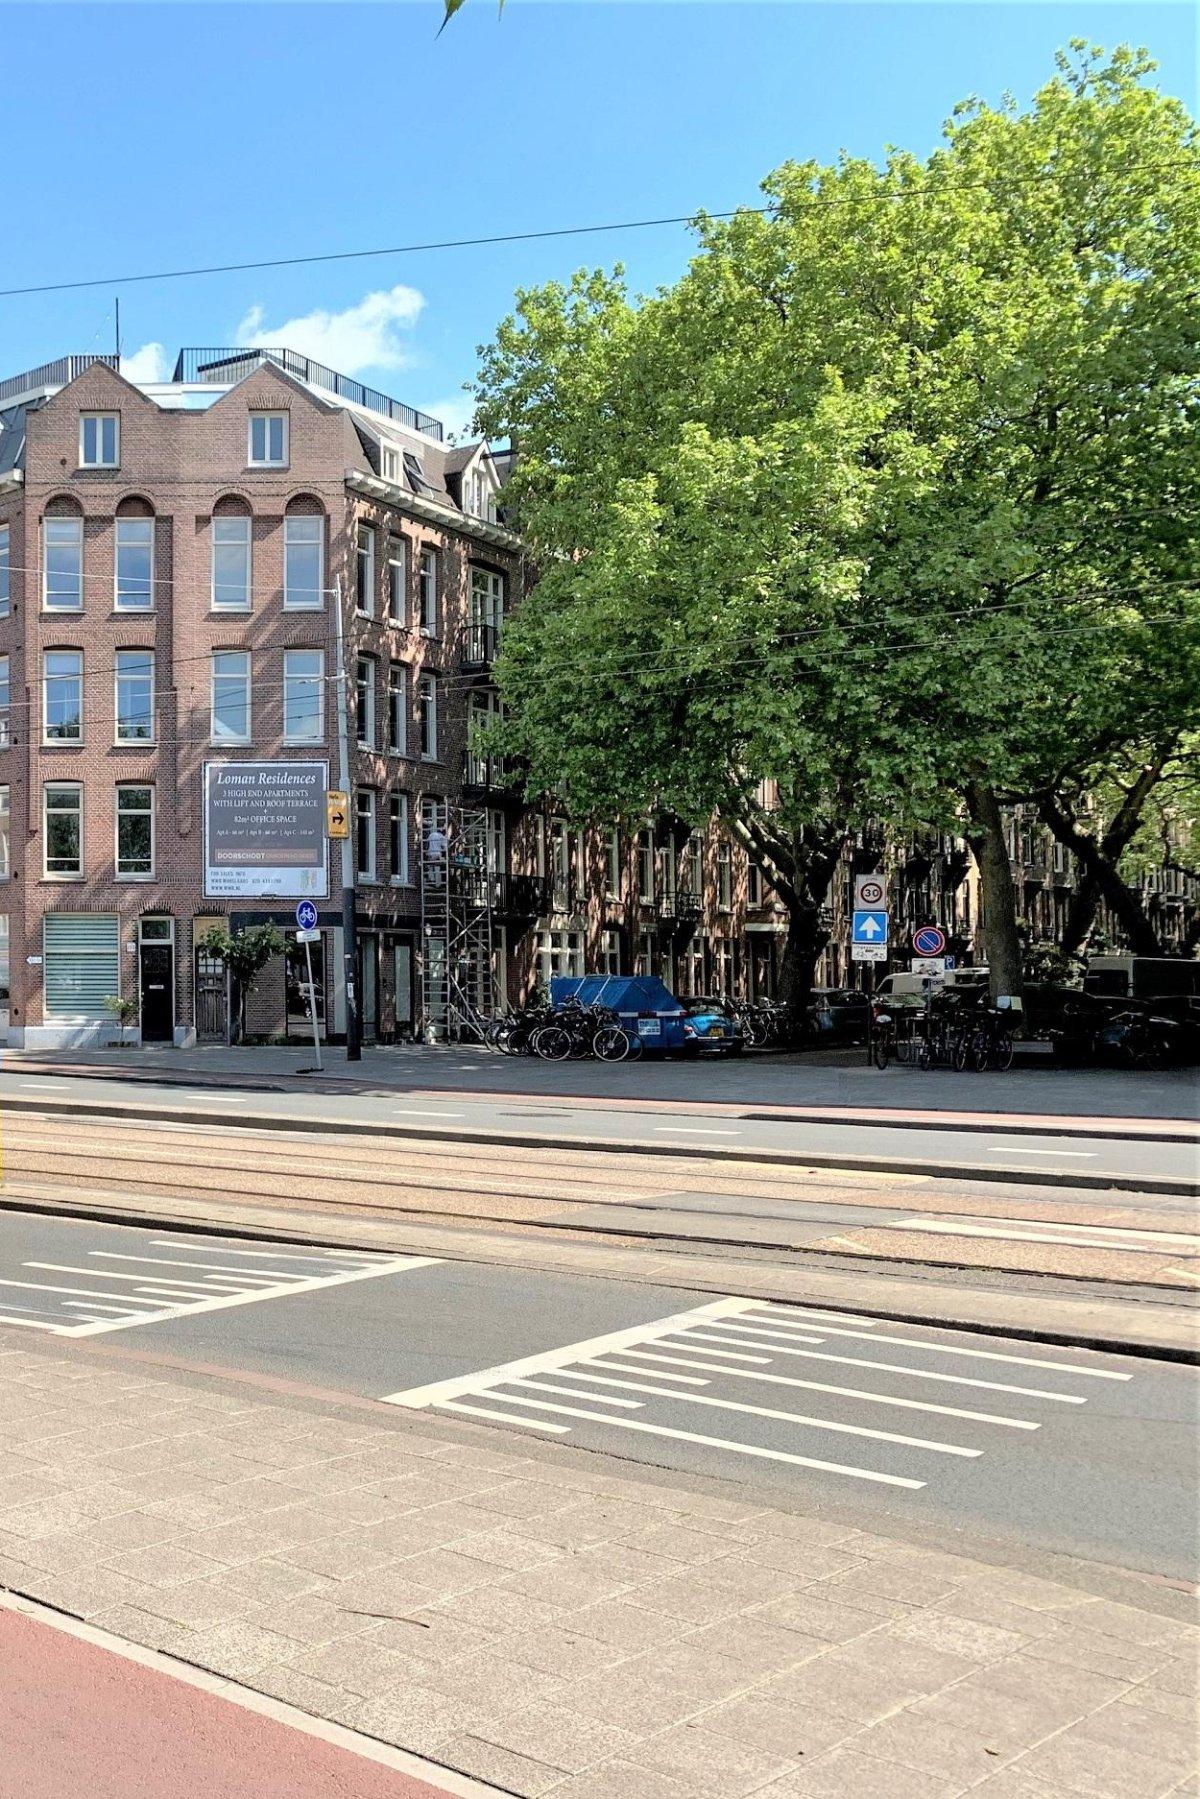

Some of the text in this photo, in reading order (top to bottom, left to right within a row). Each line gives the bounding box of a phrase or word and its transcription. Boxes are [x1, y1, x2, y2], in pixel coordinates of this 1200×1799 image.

[217, 772, 316, 785] Loman Residences
[213, 800, 233, 808] WITH
[233, 800, 248, 808] LIFT
[864, 889, 879, 898] 30
